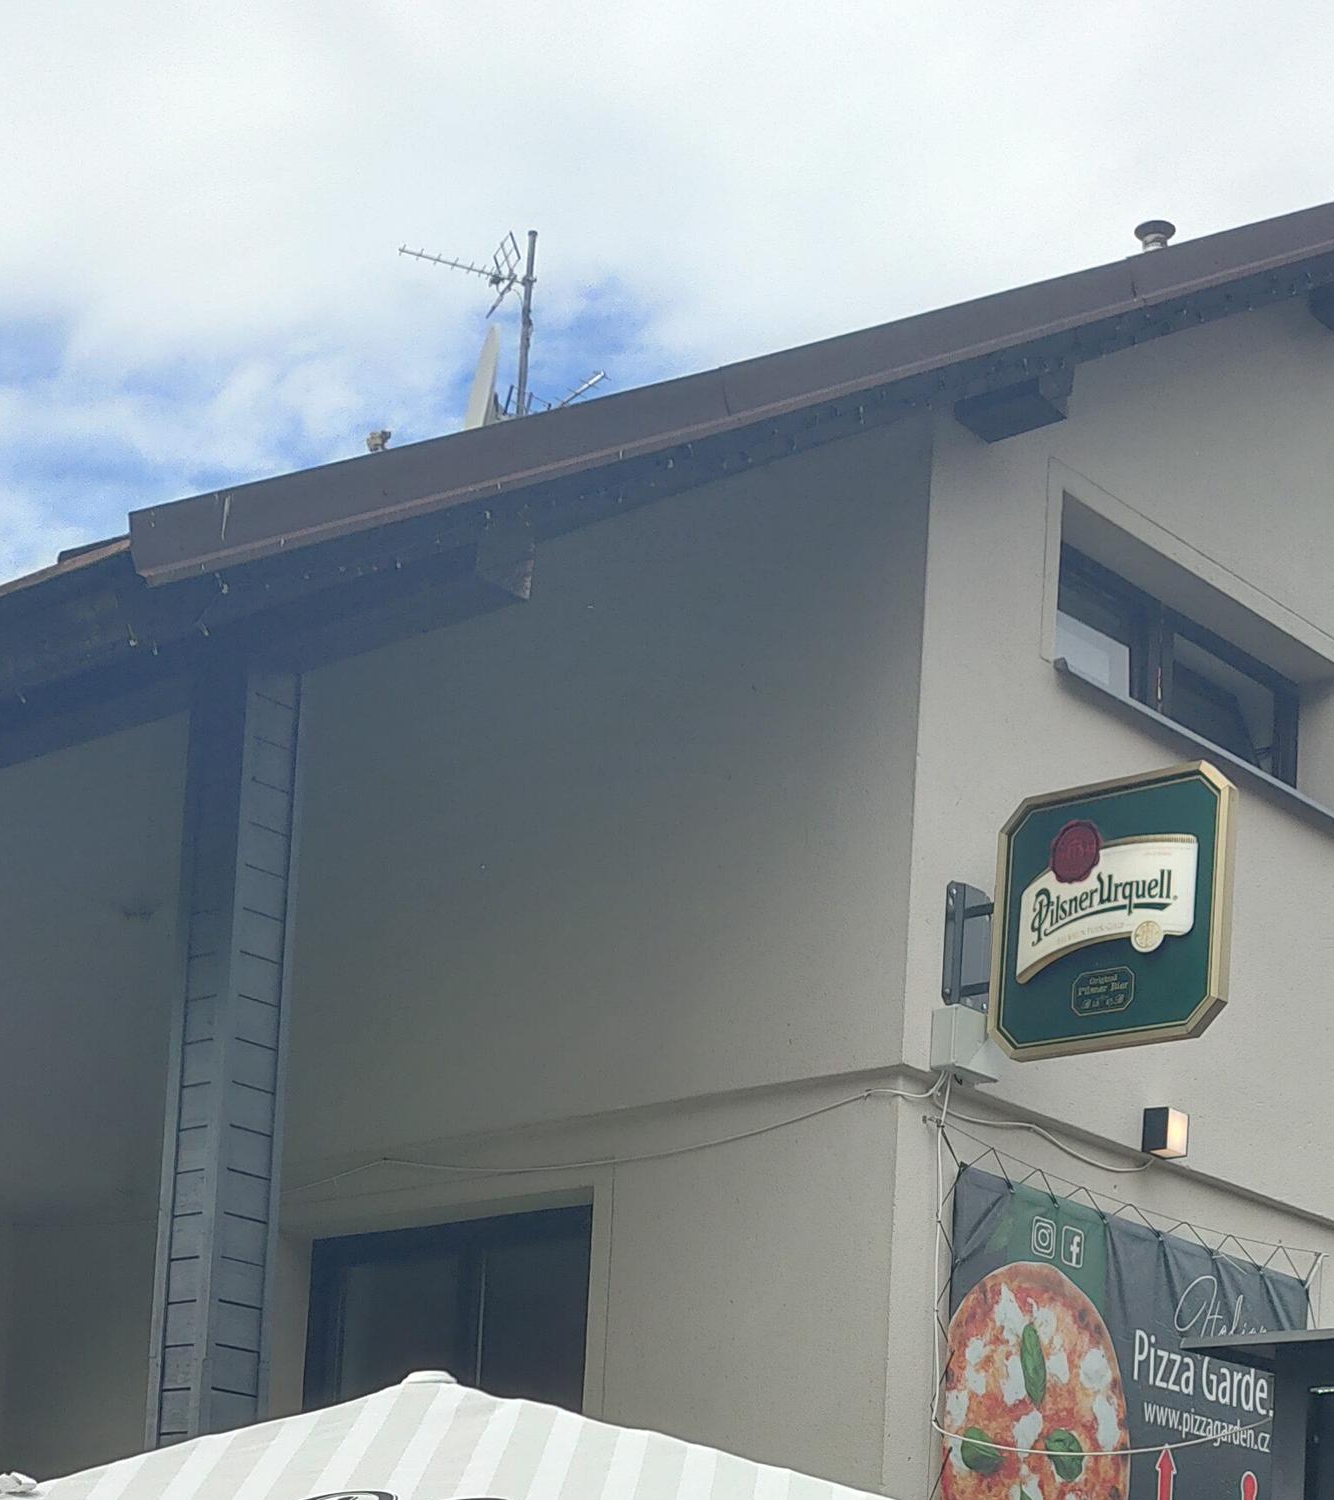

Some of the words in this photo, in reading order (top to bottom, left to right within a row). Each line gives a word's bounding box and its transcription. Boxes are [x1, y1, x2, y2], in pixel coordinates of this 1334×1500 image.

[1031, 887, 1098, 946] Pilsner
[1097, 869, 1172, 915] Urquell
[1133, 1329, 1194, 1395] Pizza
[1202, 1356, 1273, 1417] Garde
[1143, 1402, 1270, 1453] www.pizzagarden.cz
